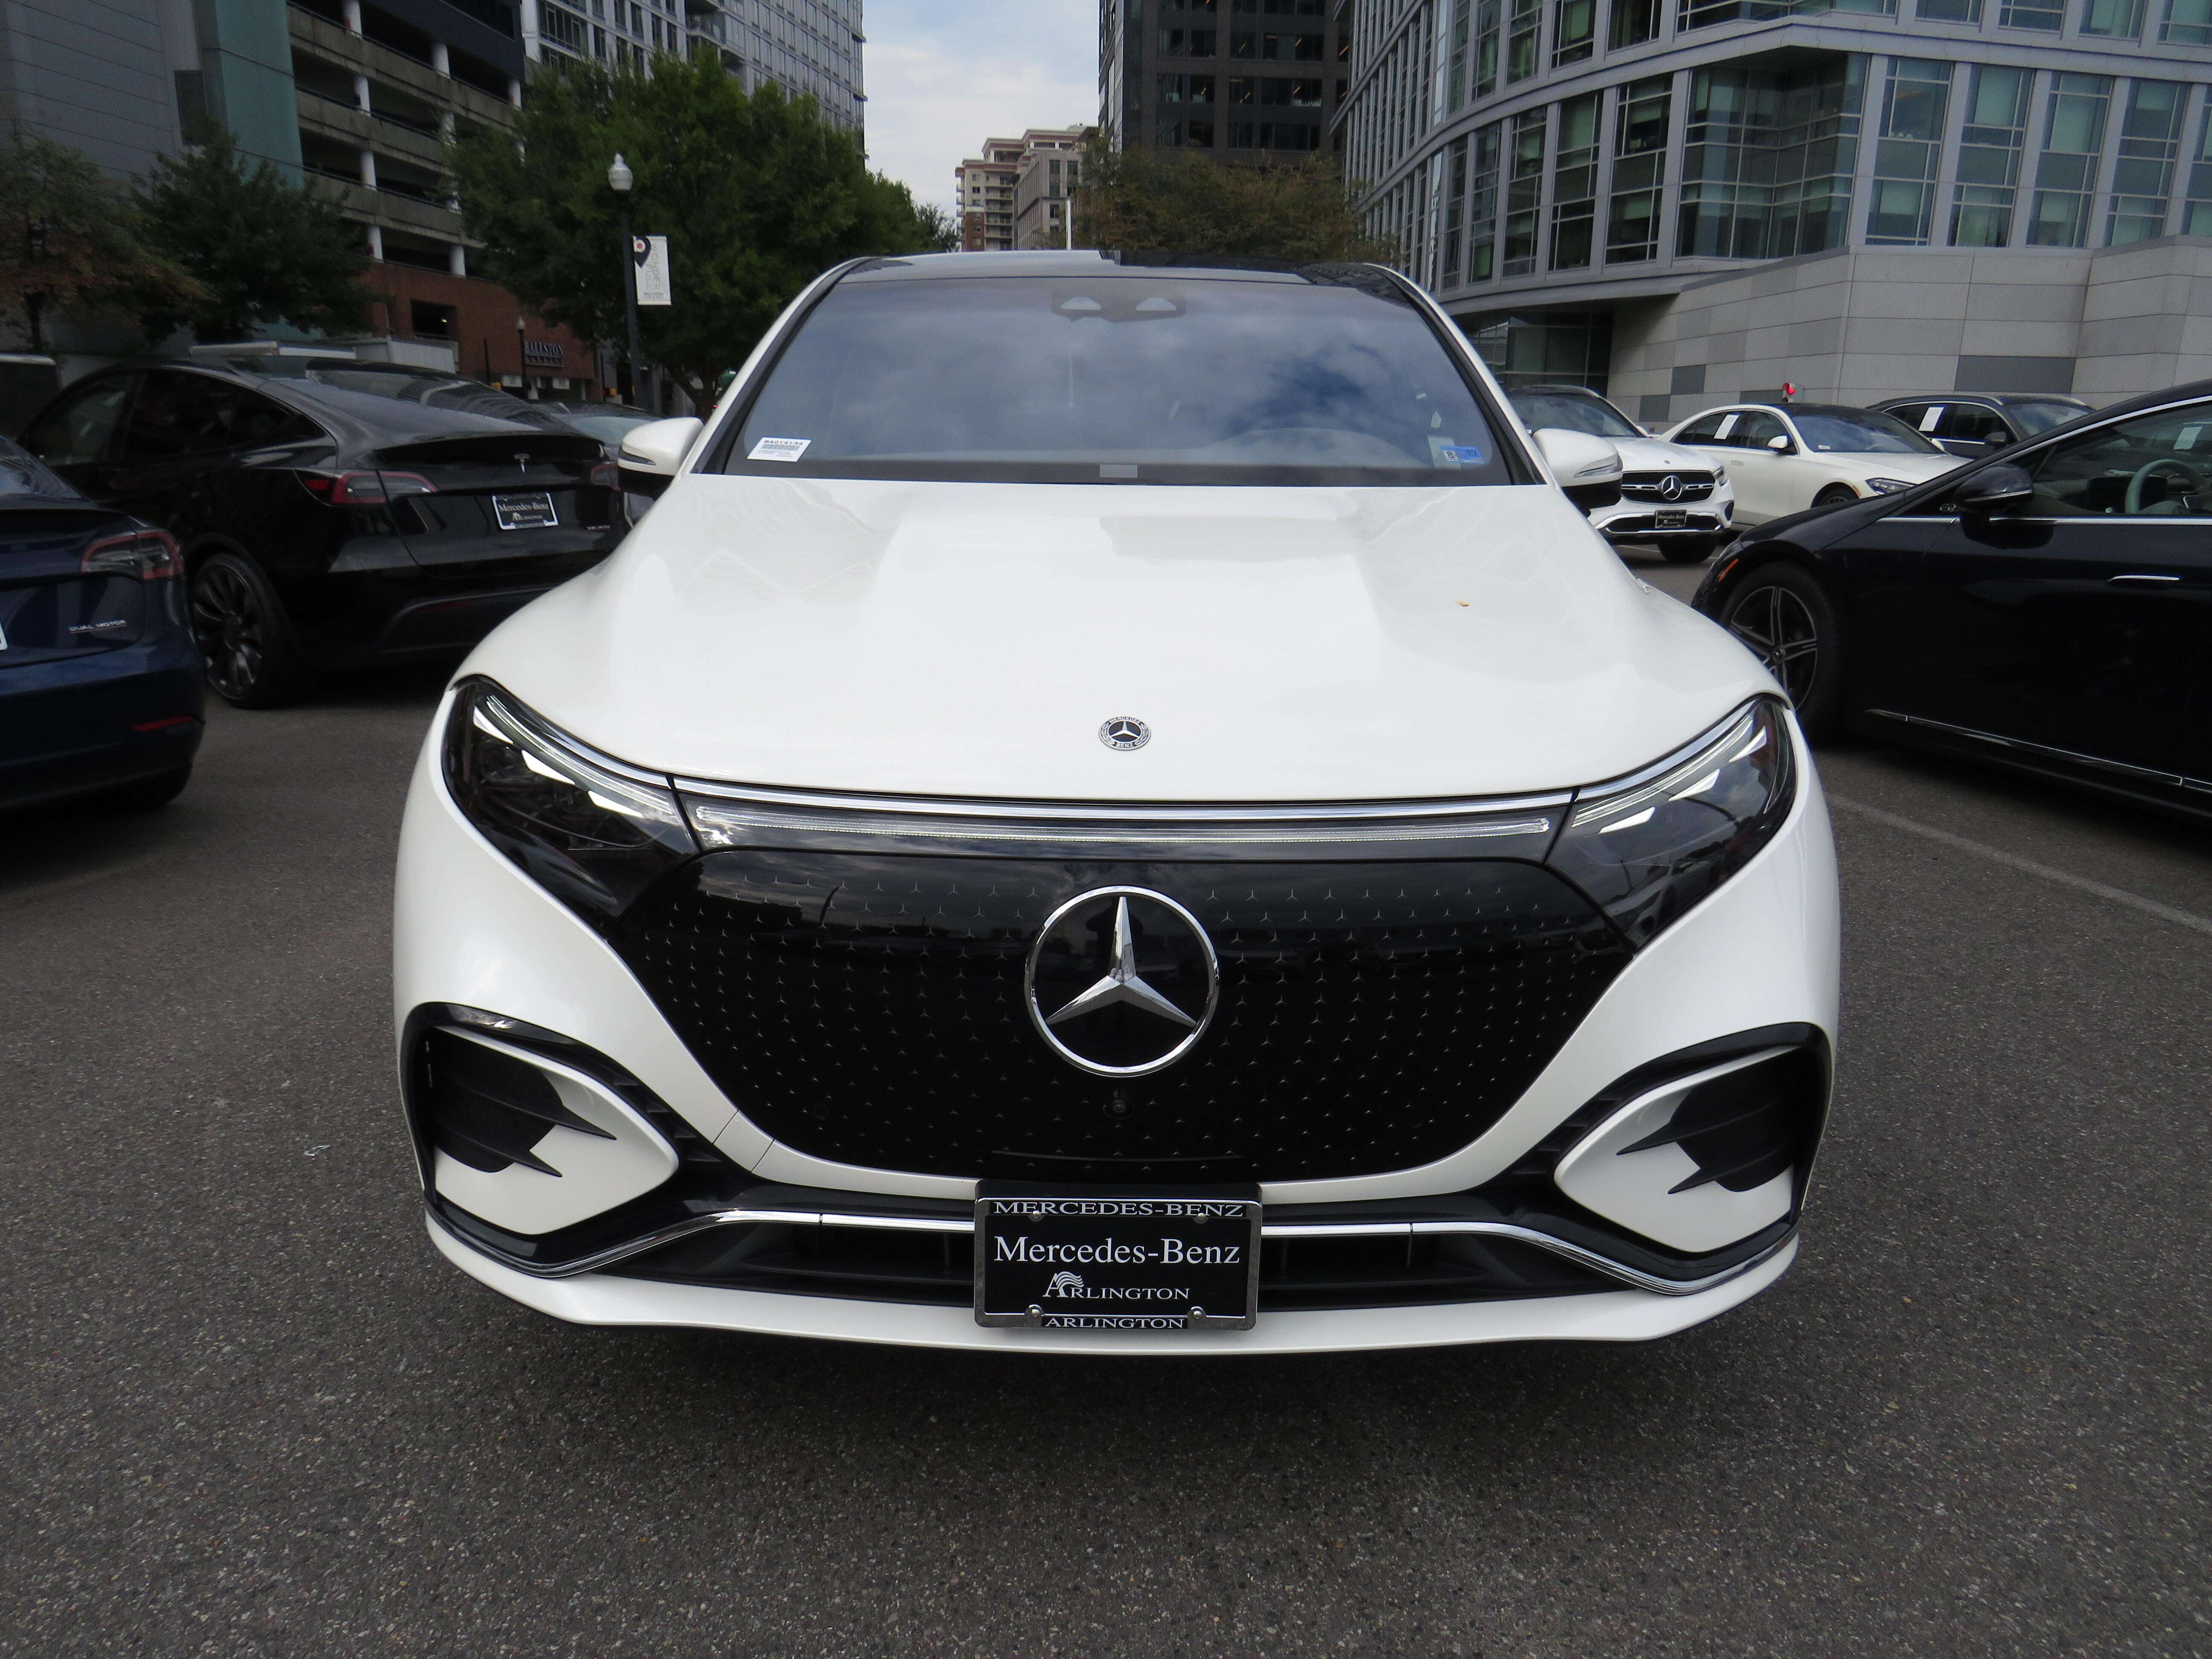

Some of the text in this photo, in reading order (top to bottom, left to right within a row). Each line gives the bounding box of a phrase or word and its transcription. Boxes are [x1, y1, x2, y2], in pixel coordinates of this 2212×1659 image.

[524, 341, 564, 356] BALLSTON
[1447, 451, 1454, 459] 8
[498, 502, 550, 512] Mercedes-Benz
[95, 620, 126, 628] MOTOR
[993, 1201, 1243, 1217] MERCEDES-BENZ
[993, 1236, 1240, 1263] Mercedes-Benz
[1042, 1271, 1190, 1300] ARLINGTON
[1044, 1317, 1185, 1329] ARLINGTON
